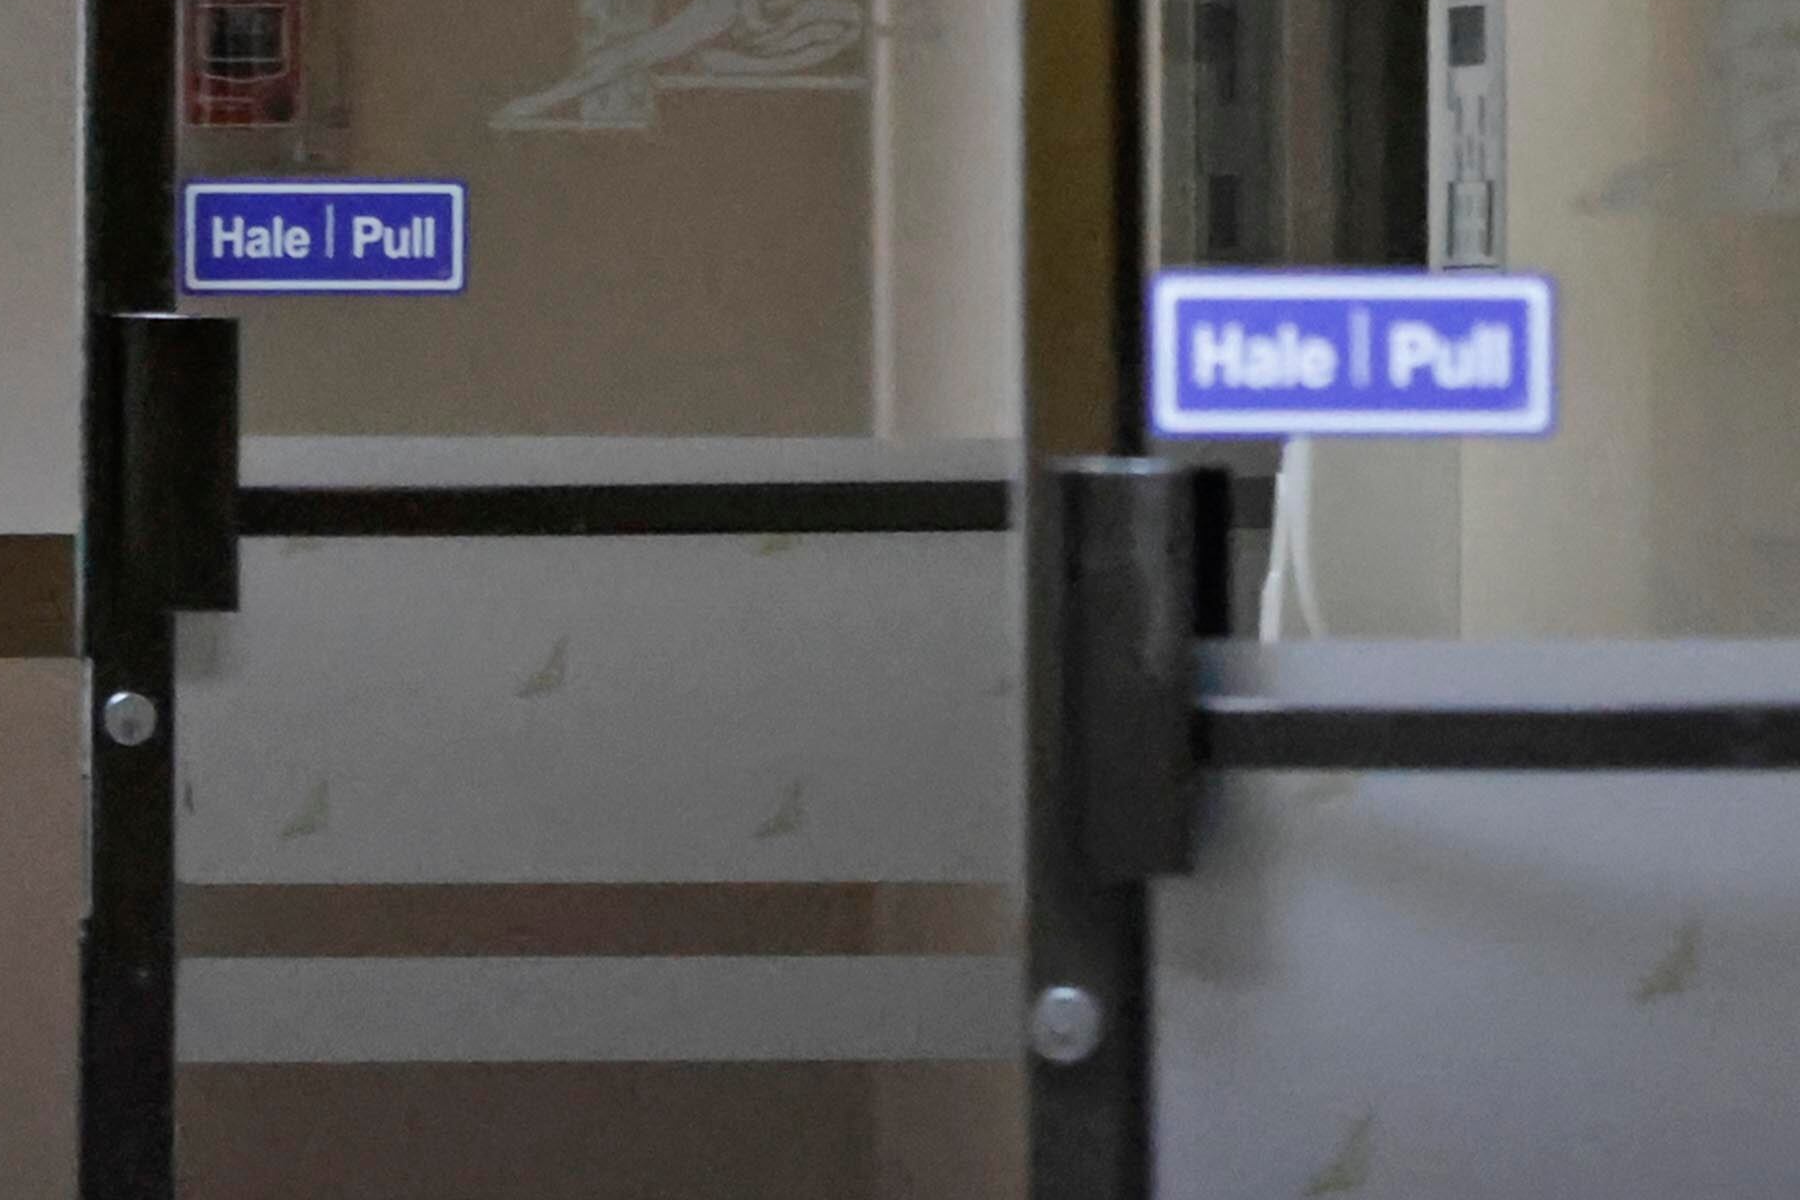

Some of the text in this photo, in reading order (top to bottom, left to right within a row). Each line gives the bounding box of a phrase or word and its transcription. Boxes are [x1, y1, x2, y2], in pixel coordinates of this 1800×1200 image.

[211, 215, 436, 259] Hale Pull
[1189, 319, 1513, 391] Hale Pull
